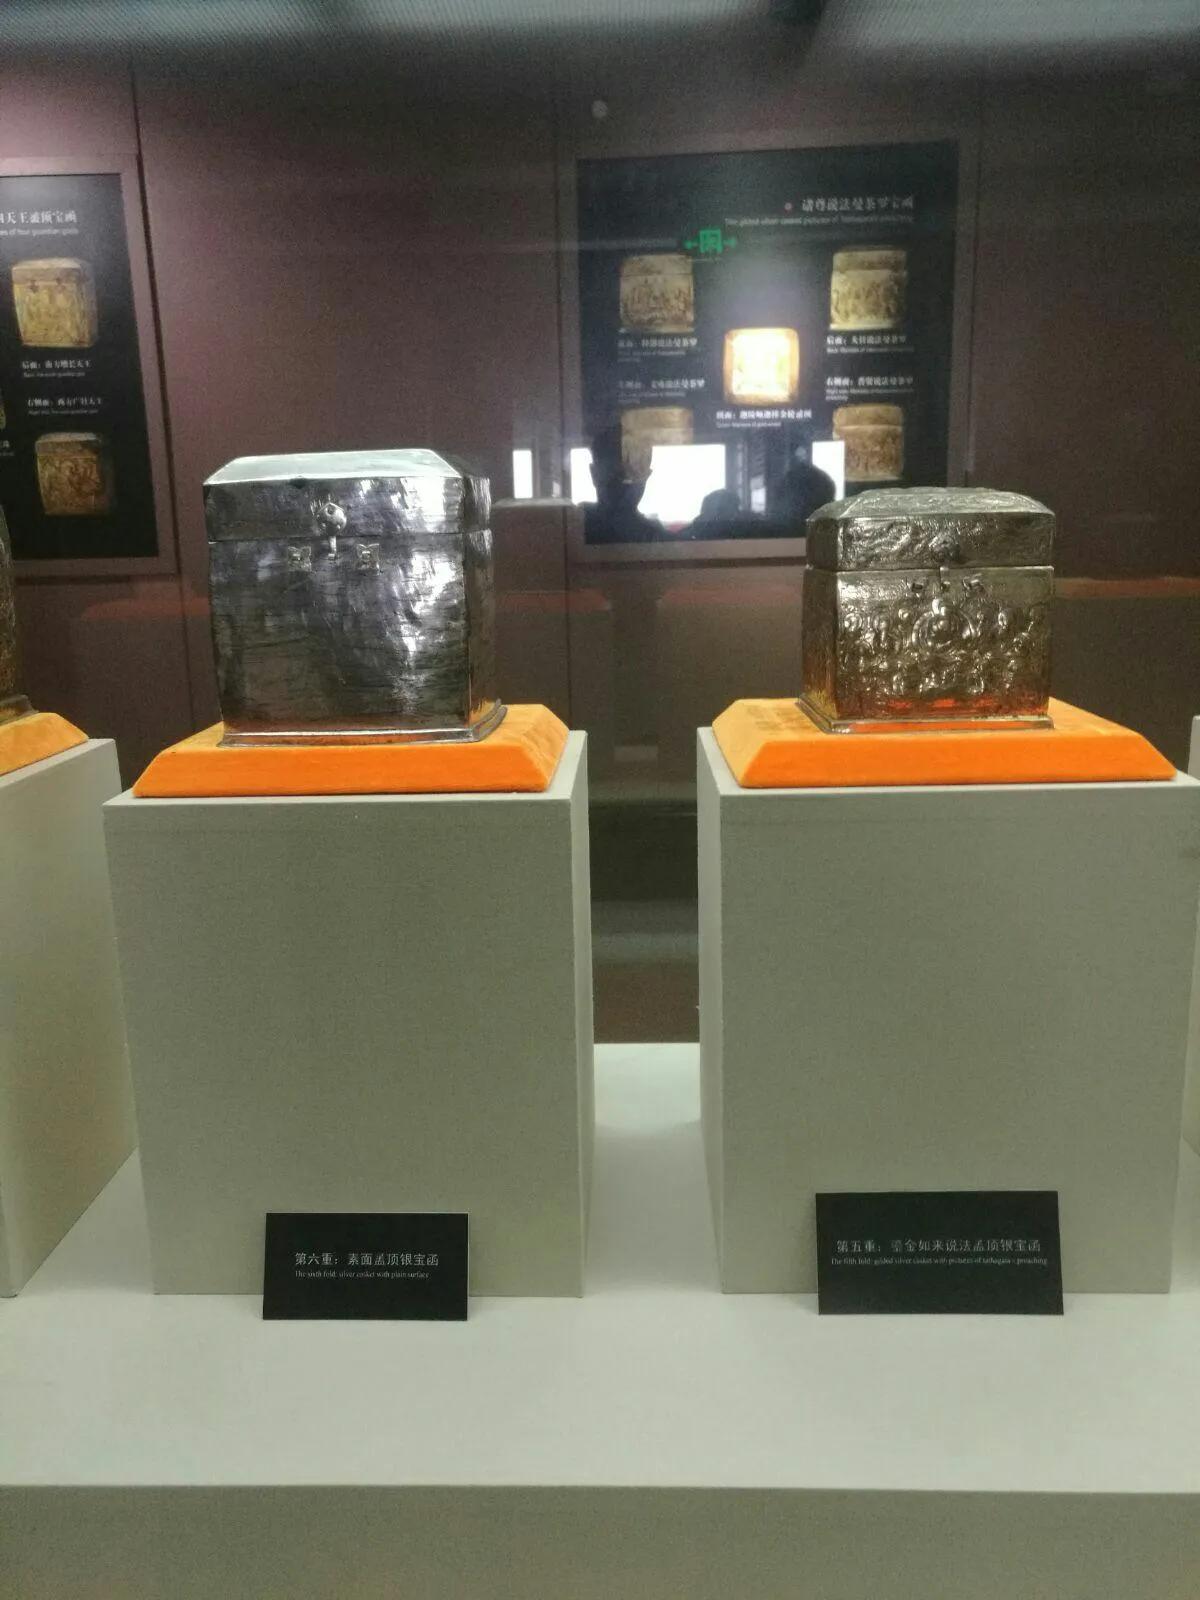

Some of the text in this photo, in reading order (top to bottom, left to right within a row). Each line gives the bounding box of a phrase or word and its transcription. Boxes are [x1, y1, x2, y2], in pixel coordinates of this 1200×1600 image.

[295, 1270, 306, 1278] The
[307, 1270, 322, 1278] sixth
[339, 1270, 355, 1278] silver
[376, 1270, 390, 1278] with
[391, 1270, 406, 1279] plain
[407, 1270, 430, 1278] surface
